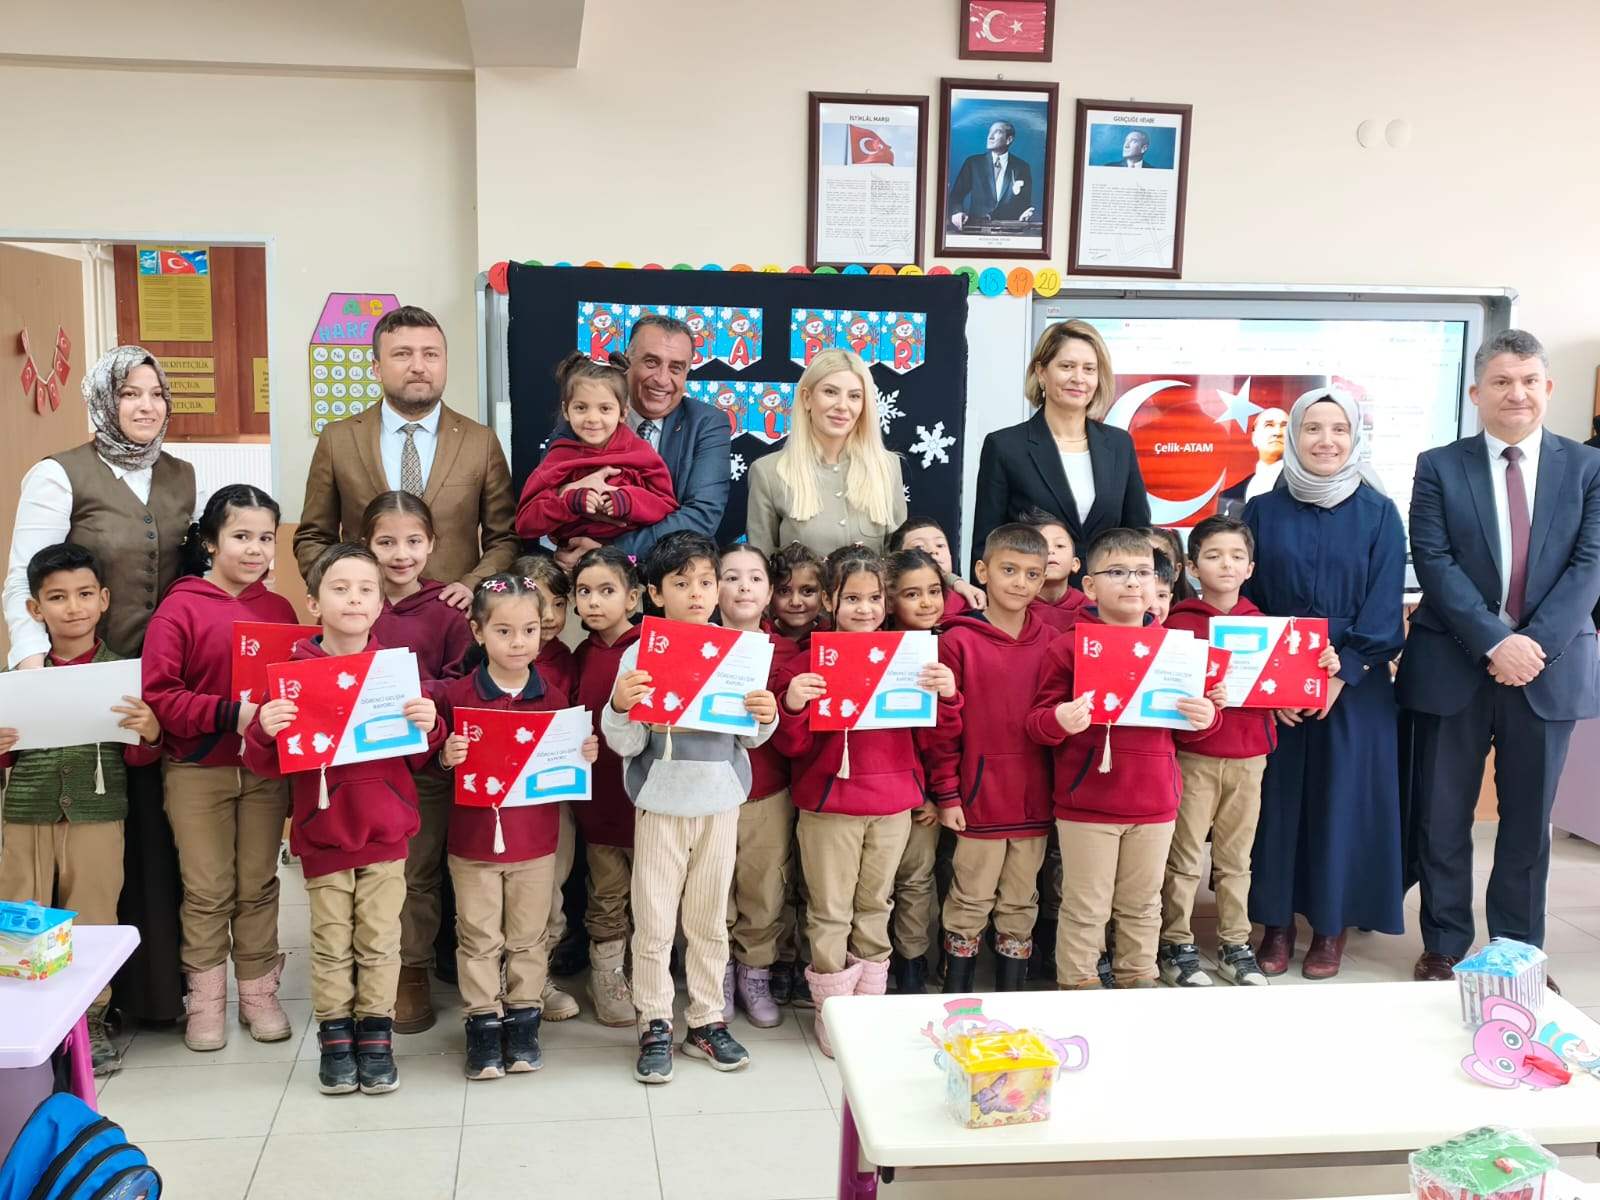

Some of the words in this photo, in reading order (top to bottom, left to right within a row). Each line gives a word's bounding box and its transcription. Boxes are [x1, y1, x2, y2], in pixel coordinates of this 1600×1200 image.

[984, 271, 999, 292] 18
[1014, 271, 1028, 292] 19
[1038, 272, 1058, 291] 20
[1154, 442, 1214, 455] Çelik-ATAM
